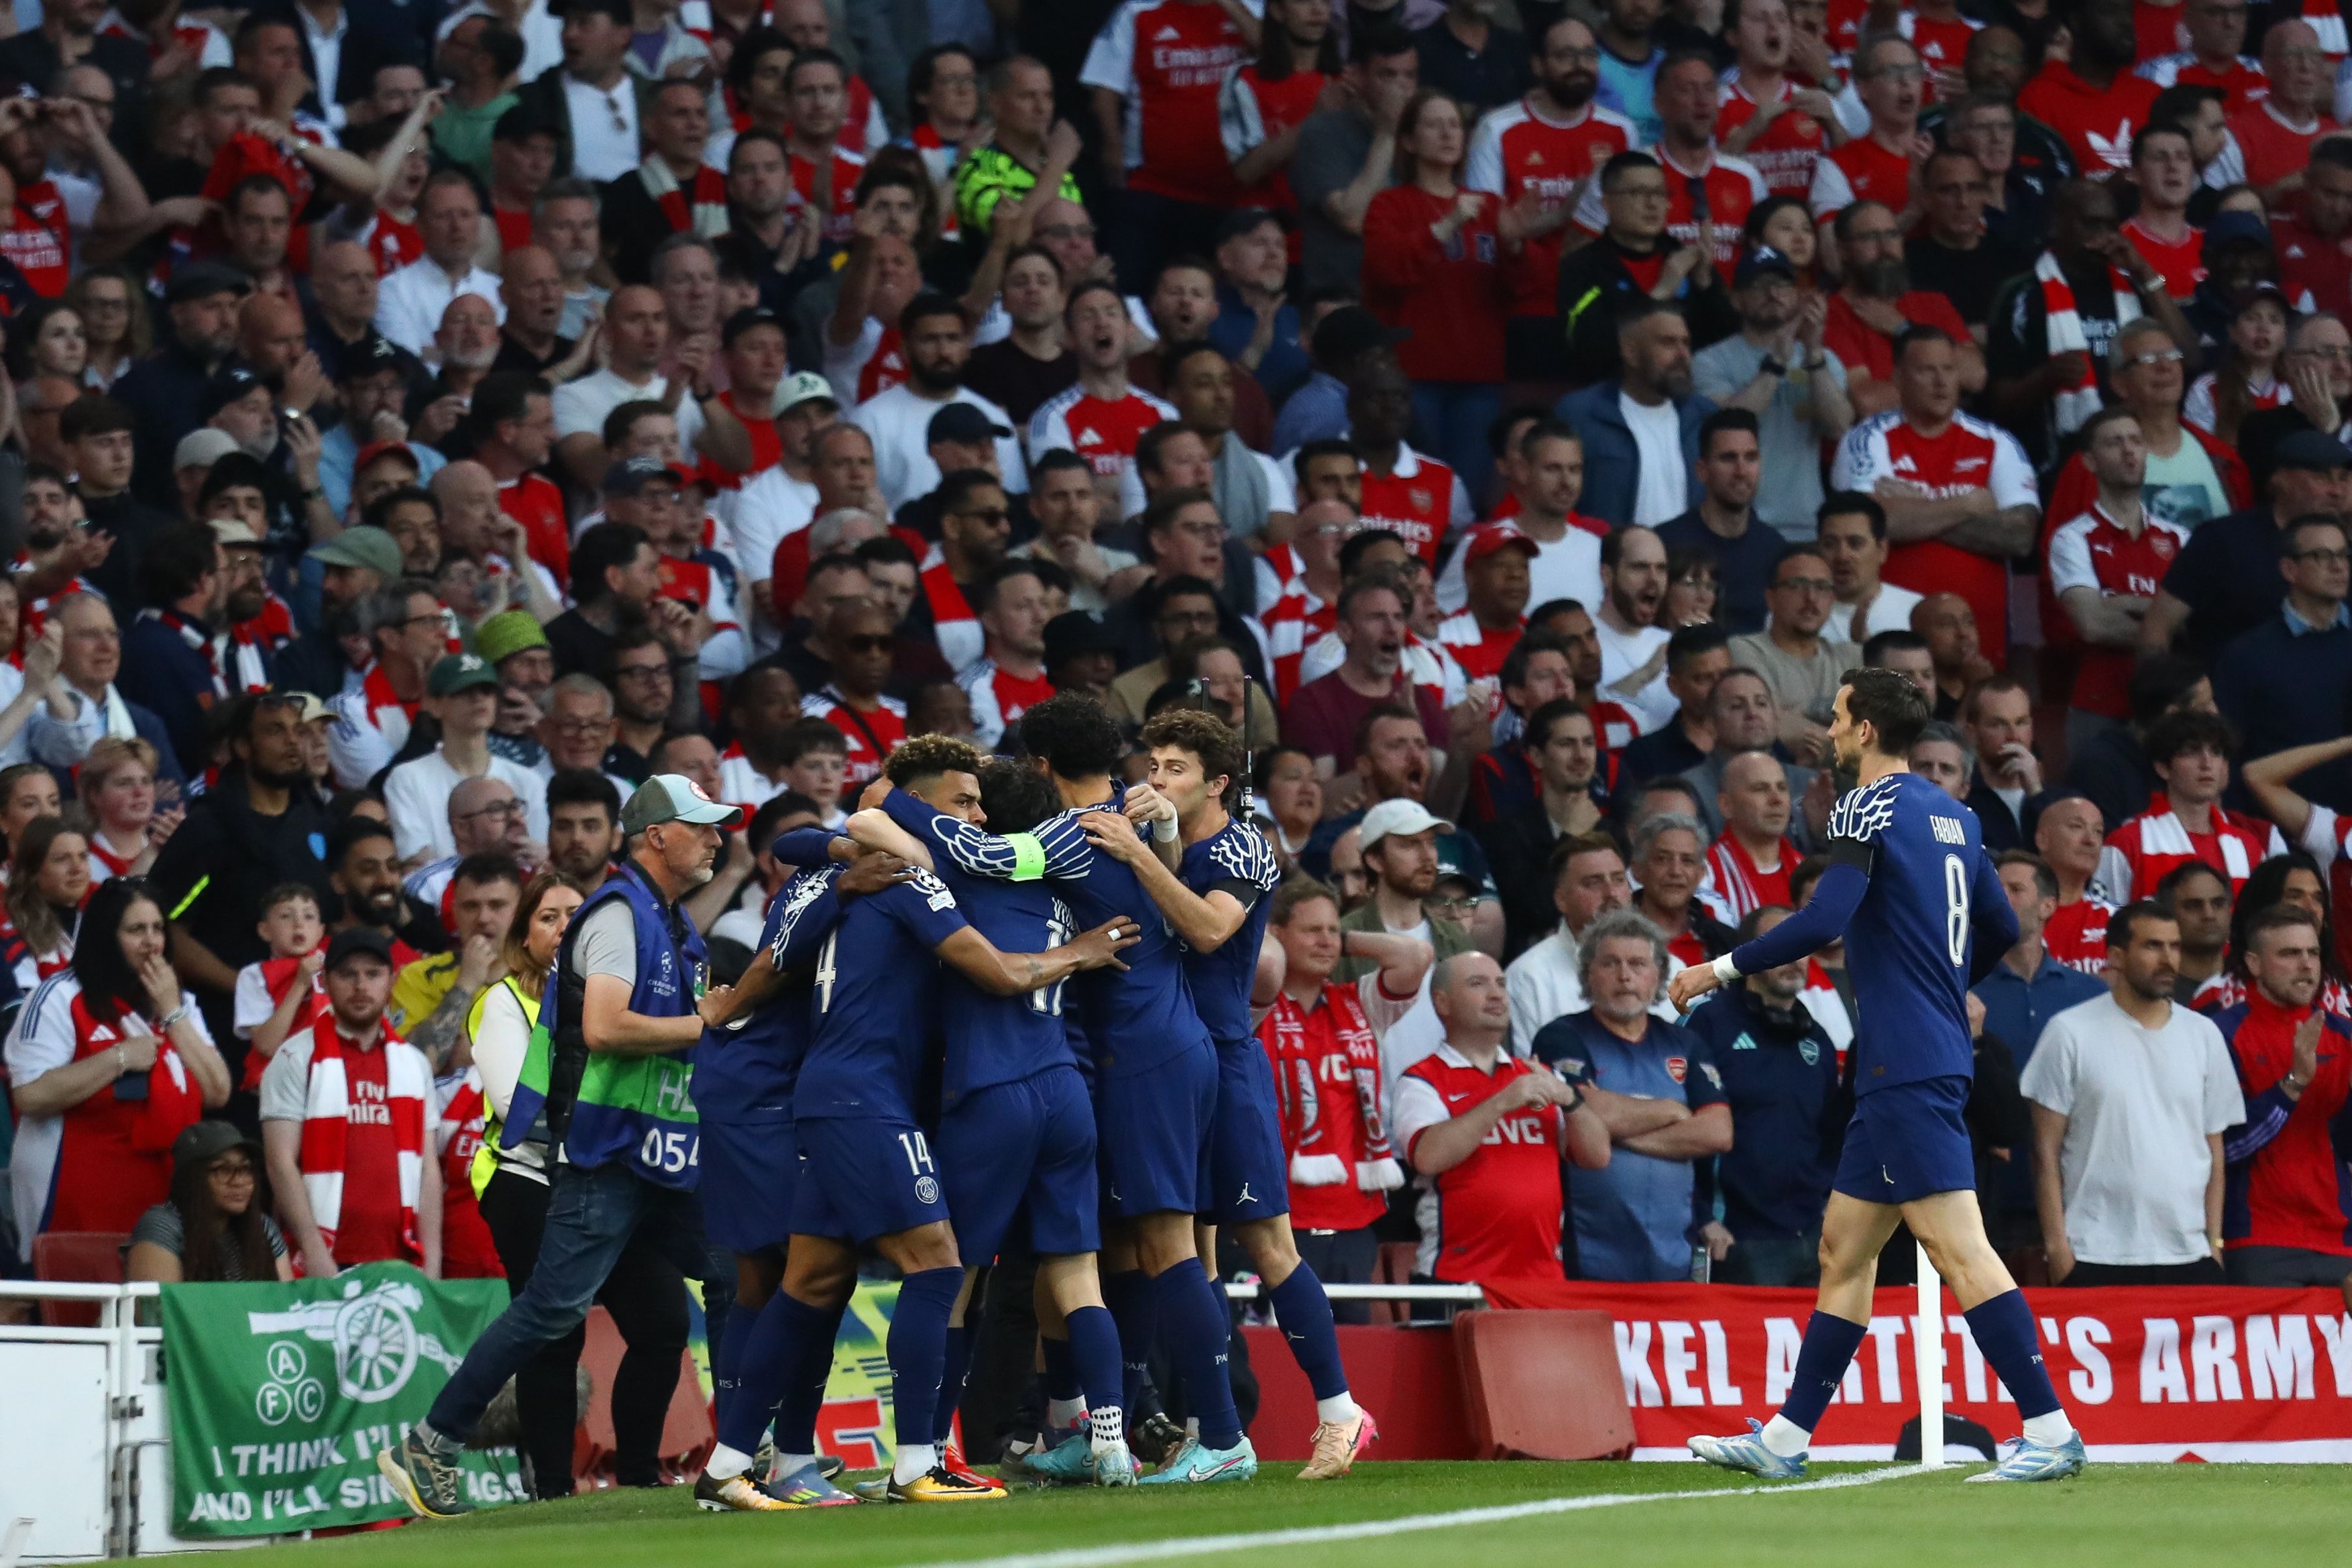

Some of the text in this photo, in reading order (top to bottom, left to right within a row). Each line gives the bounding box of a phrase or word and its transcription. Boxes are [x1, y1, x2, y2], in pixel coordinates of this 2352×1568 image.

[1929, 815, 1966, 846] FABIAN
[1945, 853, 1970, 967] 8
[355, 1080, 386, 1103] Fly
[899, 1131, 934, 1176] 14
[2140, 1312, 2352, 1404] ARMY
[231, 1437, 347, 1476] THINK
[188, 1492, 253, 1522] AND
[263, 1485, 331, 1520] I'LL
[339, 1475, 404, 1509] SIN
